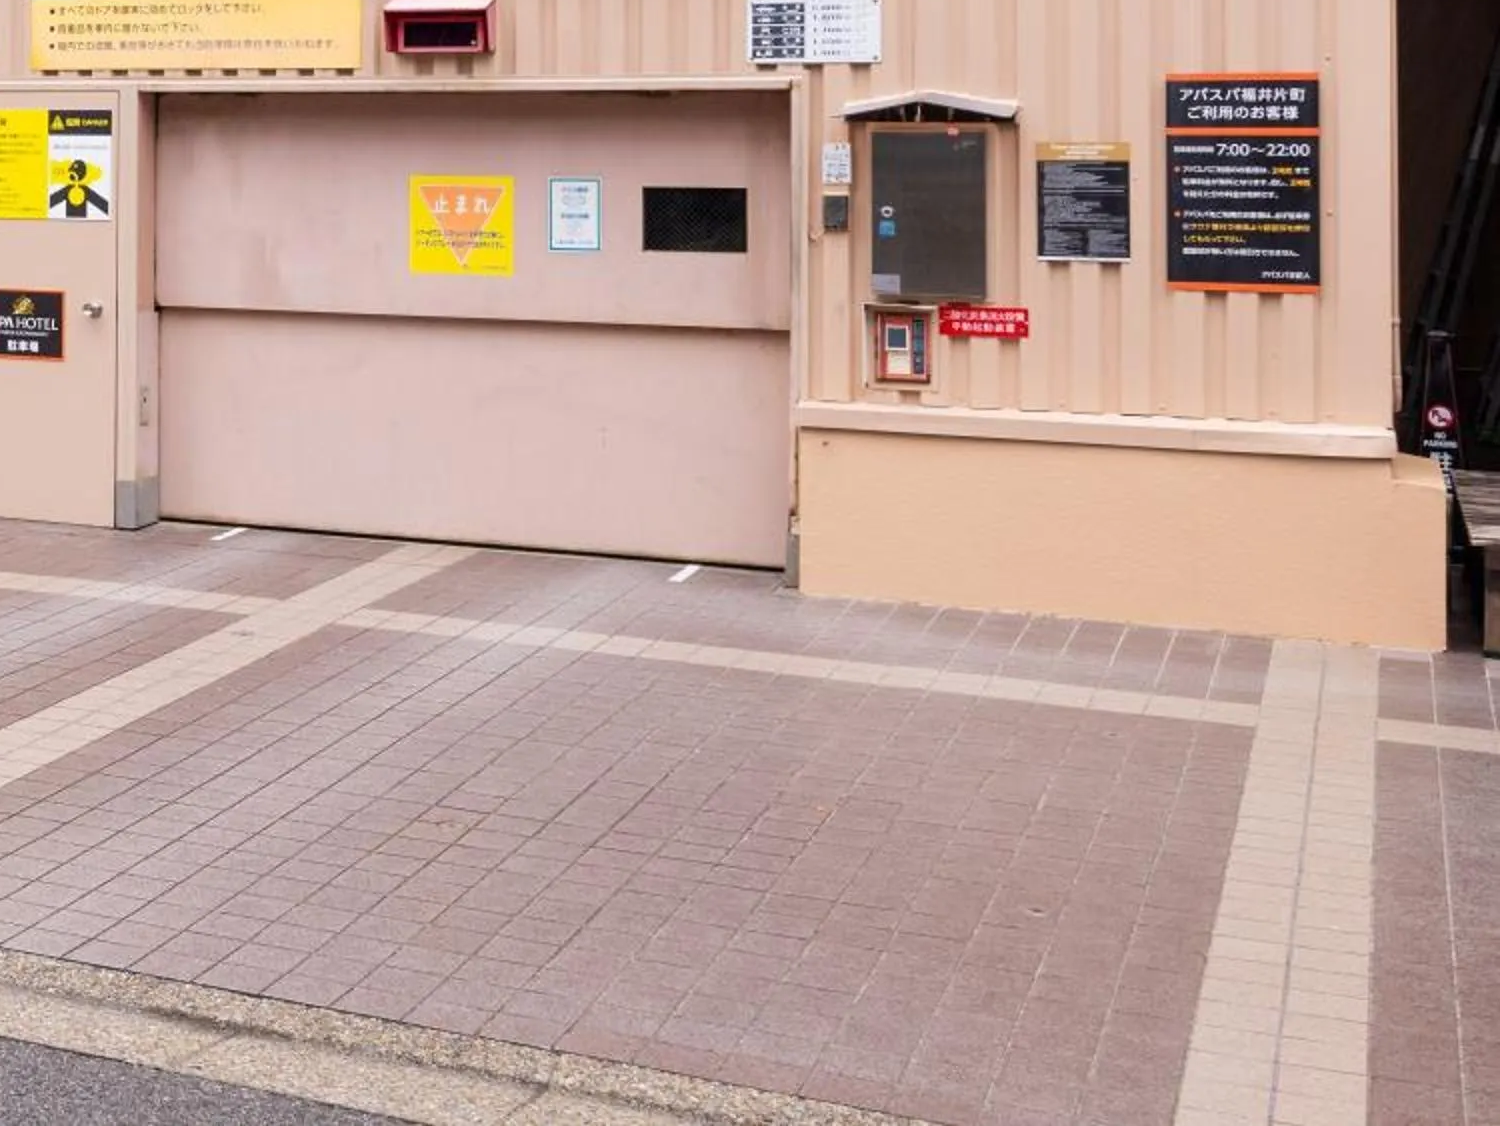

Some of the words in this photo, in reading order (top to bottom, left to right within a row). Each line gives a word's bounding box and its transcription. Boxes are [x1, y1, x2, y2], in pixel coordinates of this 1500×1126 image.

[1187, 105, 1300, 121] ご利用のお客様
[434, 193, 491, 215] 止まれ
[15, 317, 59, 331] HOTEL
